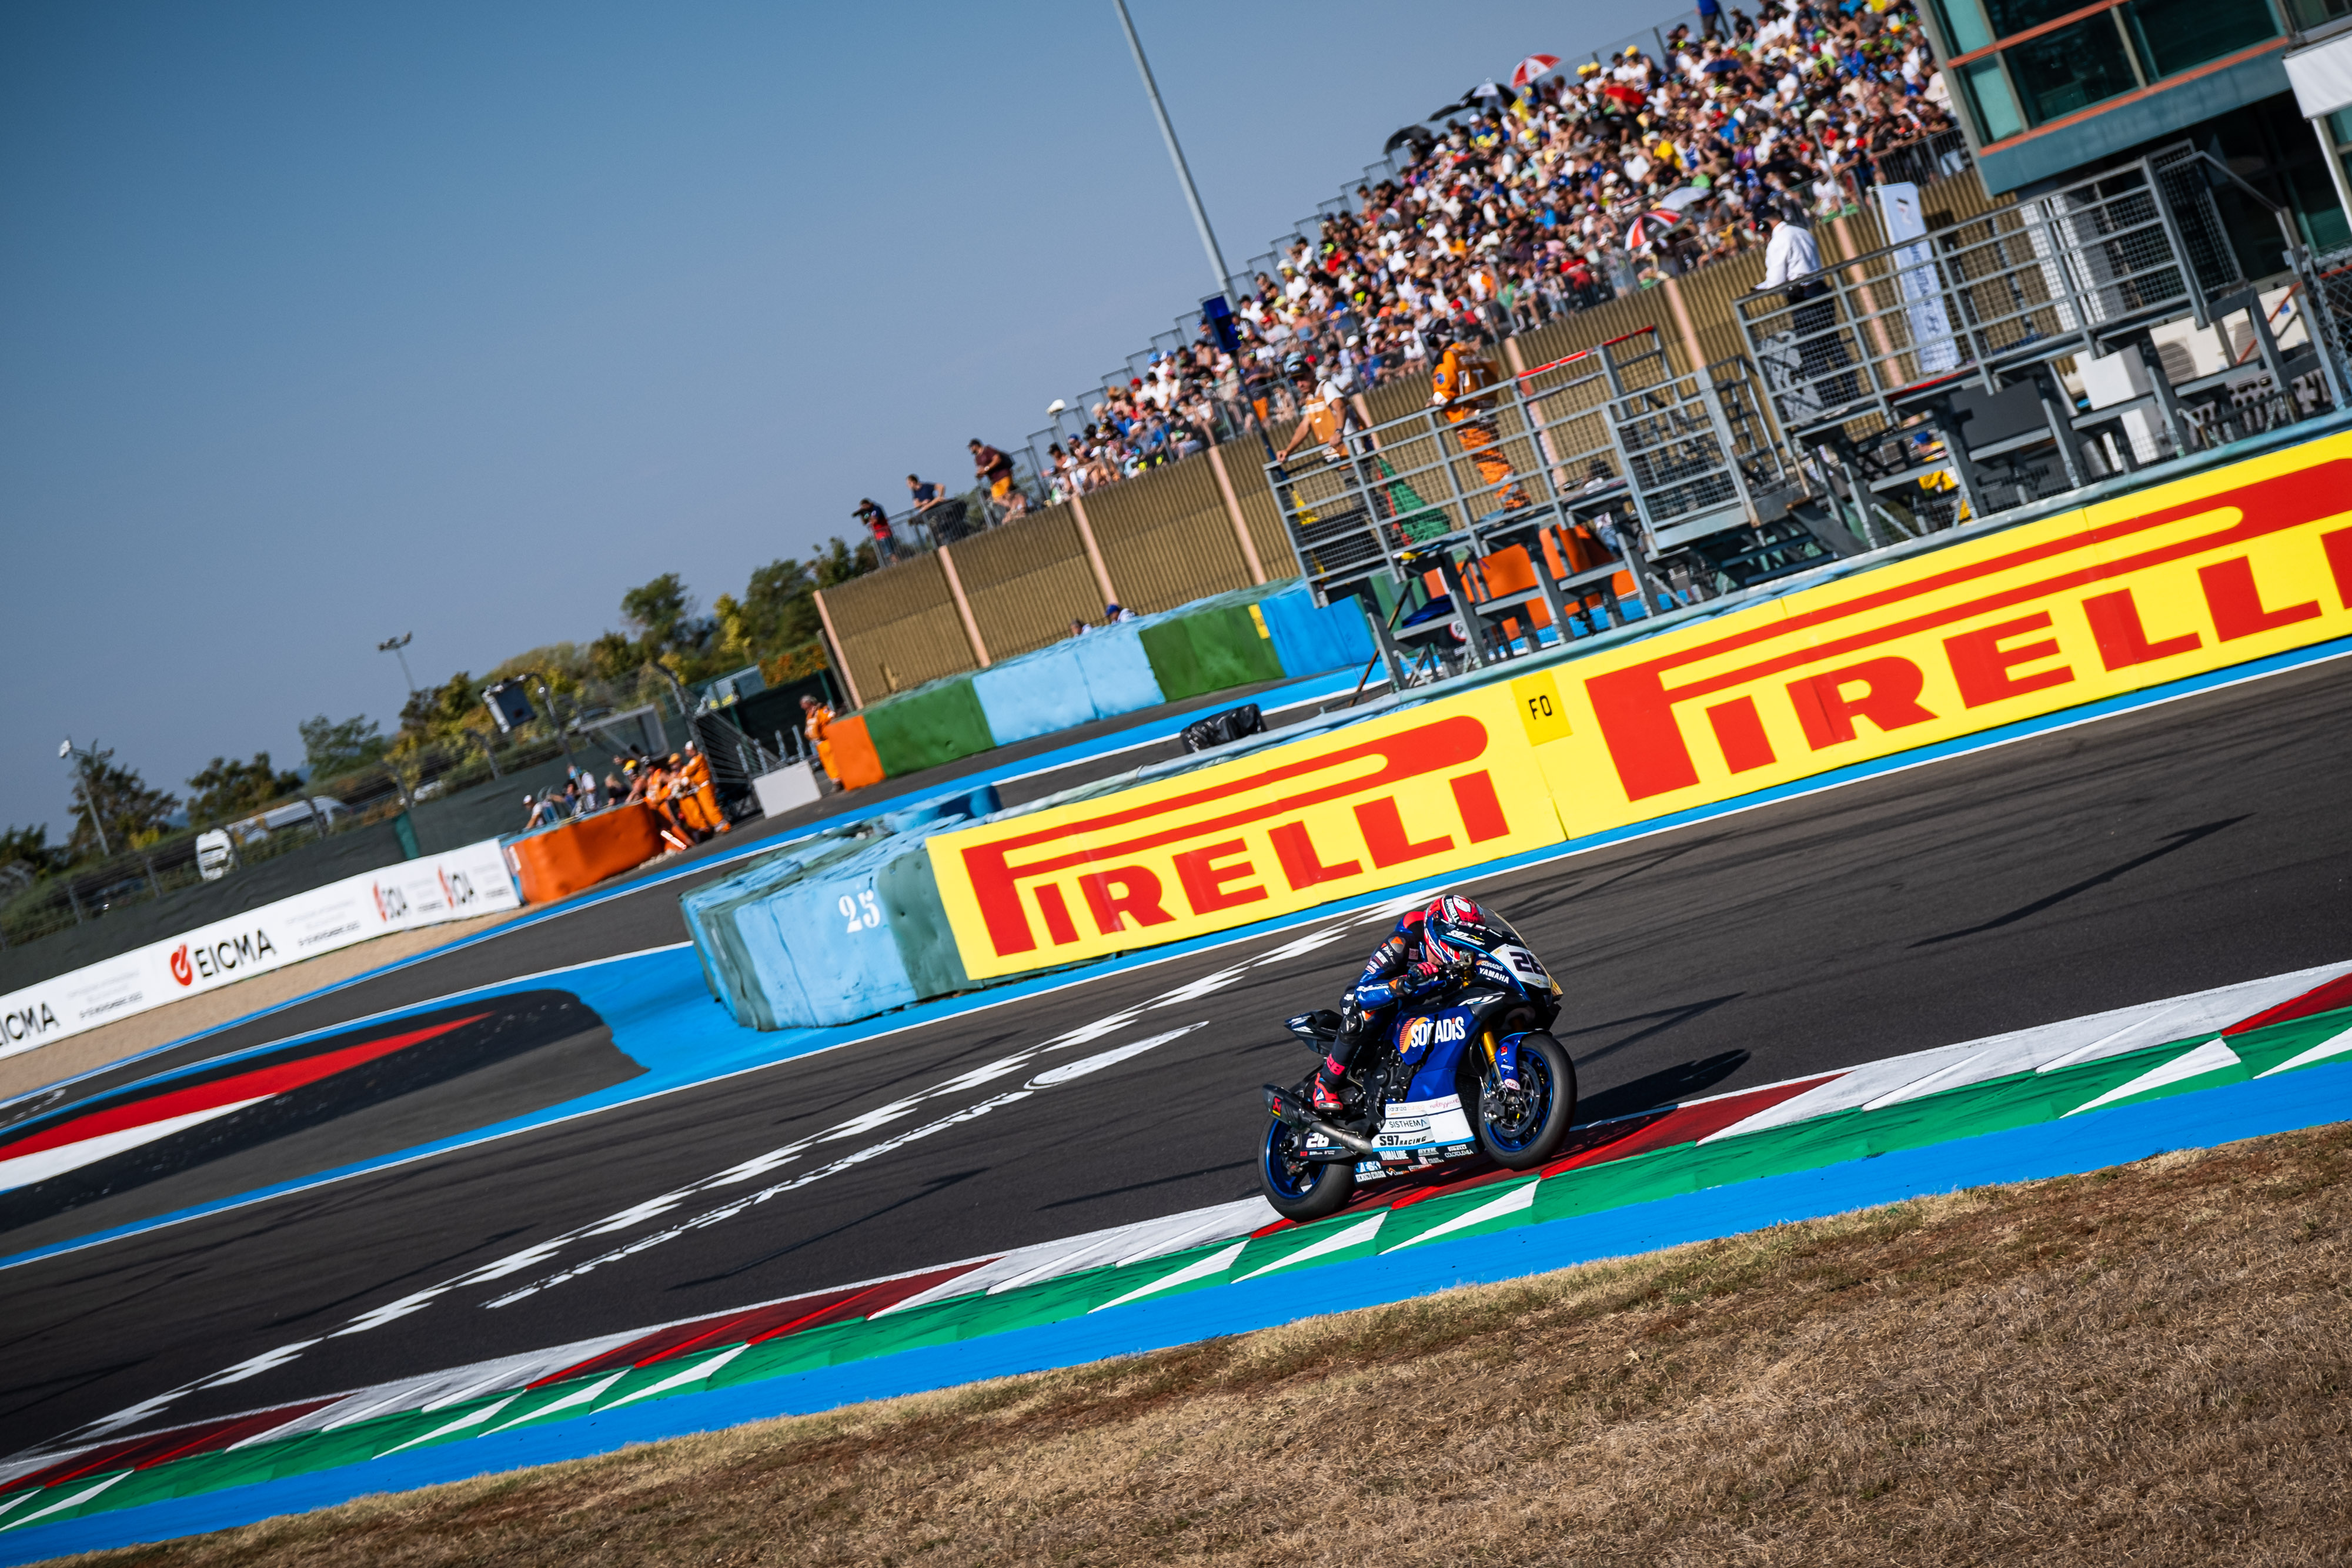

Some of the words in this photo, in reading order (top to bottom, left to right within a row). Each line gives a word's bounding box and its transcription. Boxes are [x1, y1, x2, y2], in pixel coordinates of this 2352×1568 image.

[961, 716, 1509, 957] PIRELLI
[838, 889, 880, 934] 25
[194, 927, 277, 978] EICMA
[1479, 968, 1510, 984] YAMAHA
[0, 1001, 60, 1047] ICMA
[1379, 1135, 1399, 1146] S97
[1399, 1136, 1426, 1145] RACING
